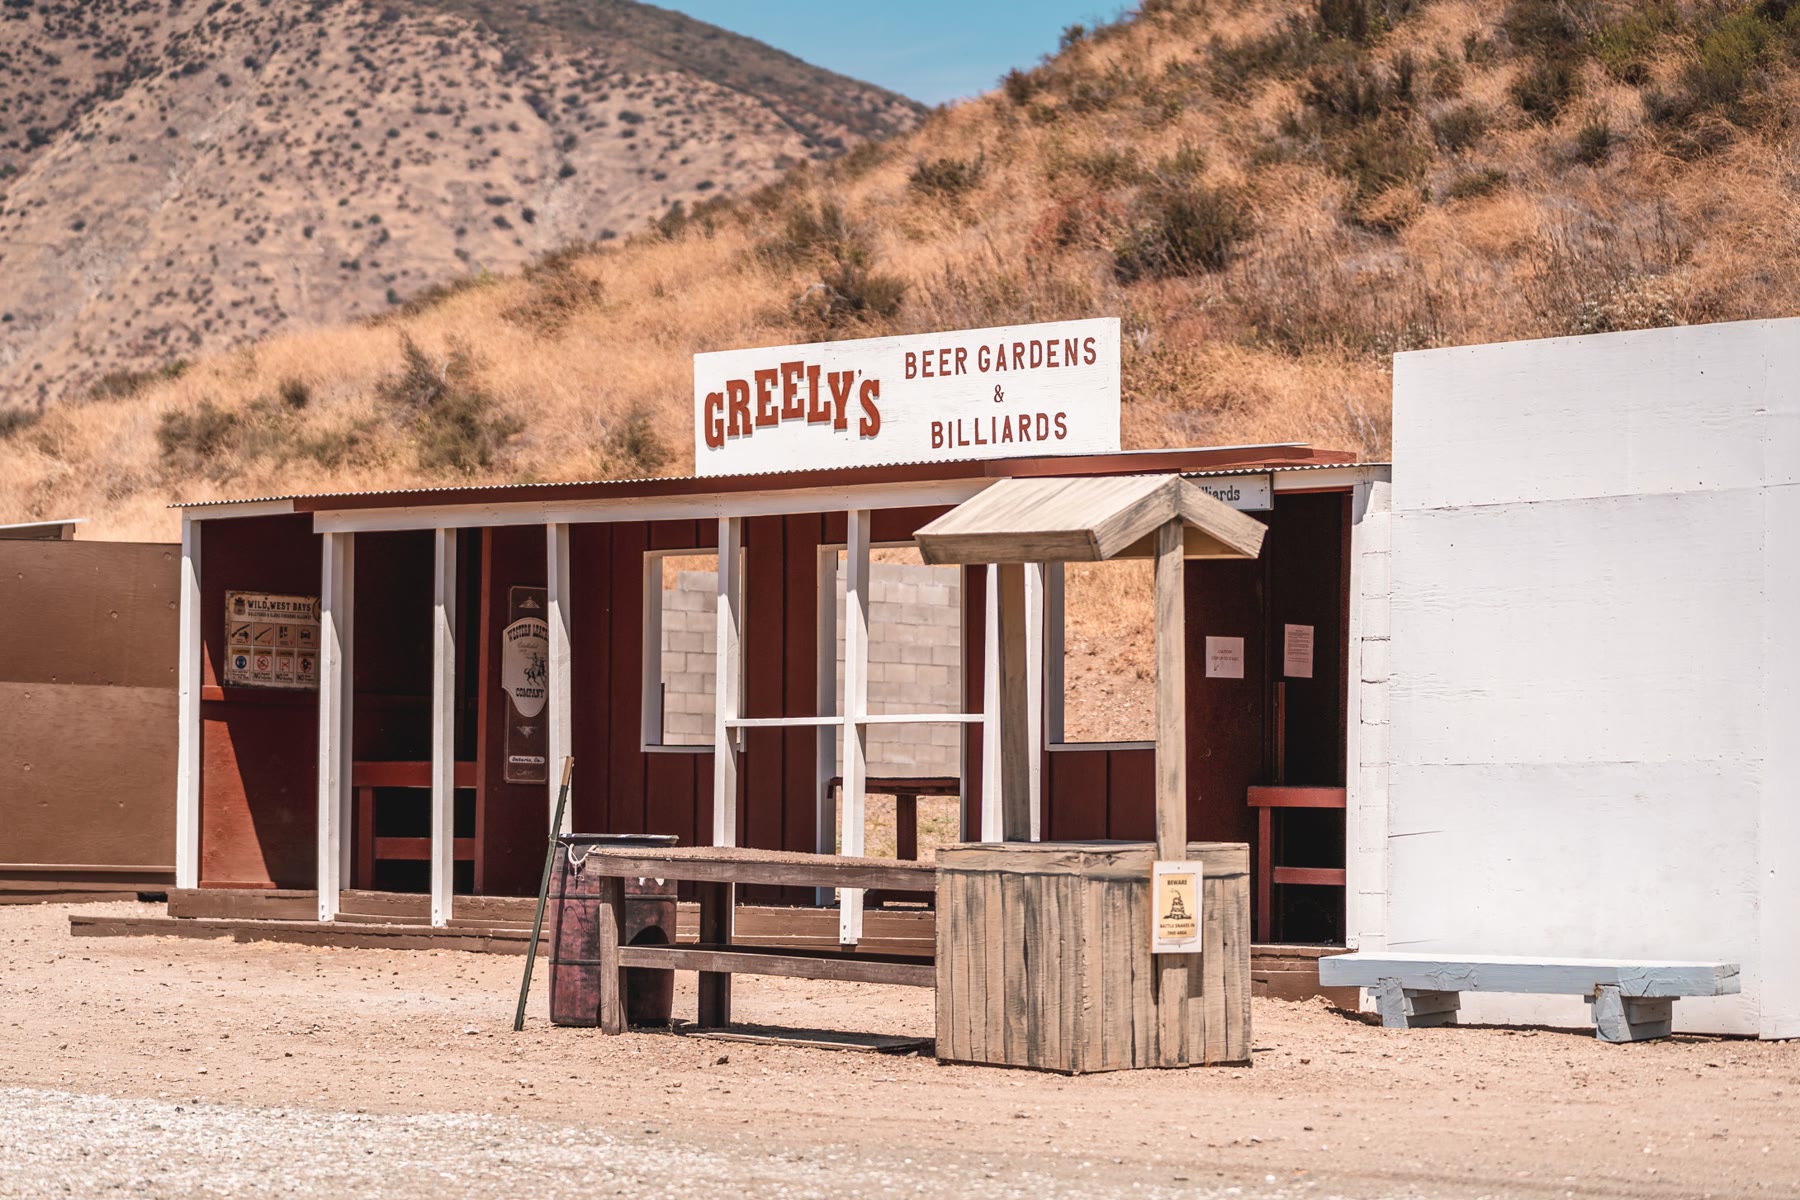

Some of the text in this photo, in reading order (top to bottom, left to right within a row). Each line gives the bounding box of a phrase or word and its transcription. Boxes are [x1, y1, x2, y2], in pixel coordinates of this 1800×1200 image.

[905, 337, 1097, 379] BEER GARDENS
[993, 384, 1005, 403] &
[704, 360, 881, 450] GREELY'S
[931, 411, 1068, 449] BILLIARDS
[248, 600, 311, 612] WILD WEST BAYS
[507, 623, 531, 642] WESTERN
[516, 687, 544, 698] COMPANY
